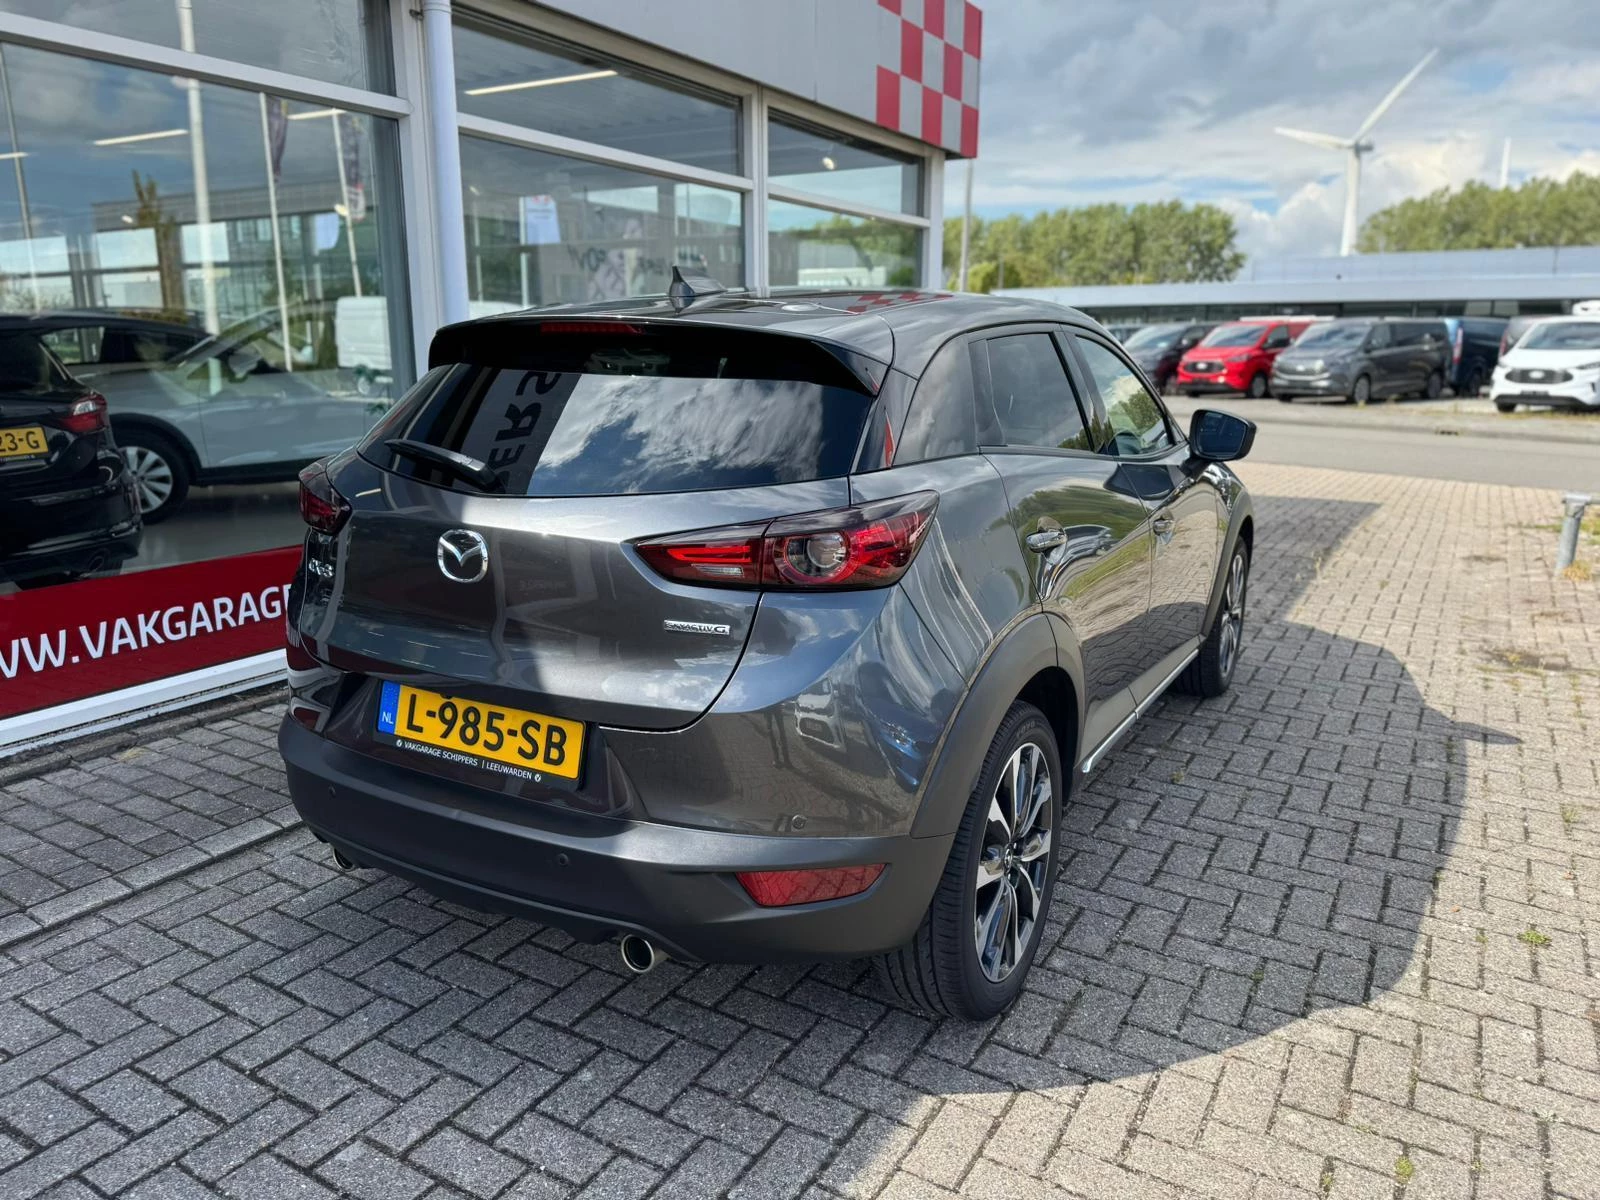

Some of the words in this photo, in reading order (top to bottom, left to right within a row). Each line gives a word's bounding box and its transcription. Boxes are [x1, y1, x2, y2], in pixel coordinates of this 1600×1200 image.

[381, 711, 394, 725] NL
[406, 693, 567, 767] L-985-SB
[404, 741, 441, 758] VAKGARAGE
[442, 751, 478, 767] SCHIPPERS
[486, 762, 533, 780] LEEUWARDEN
